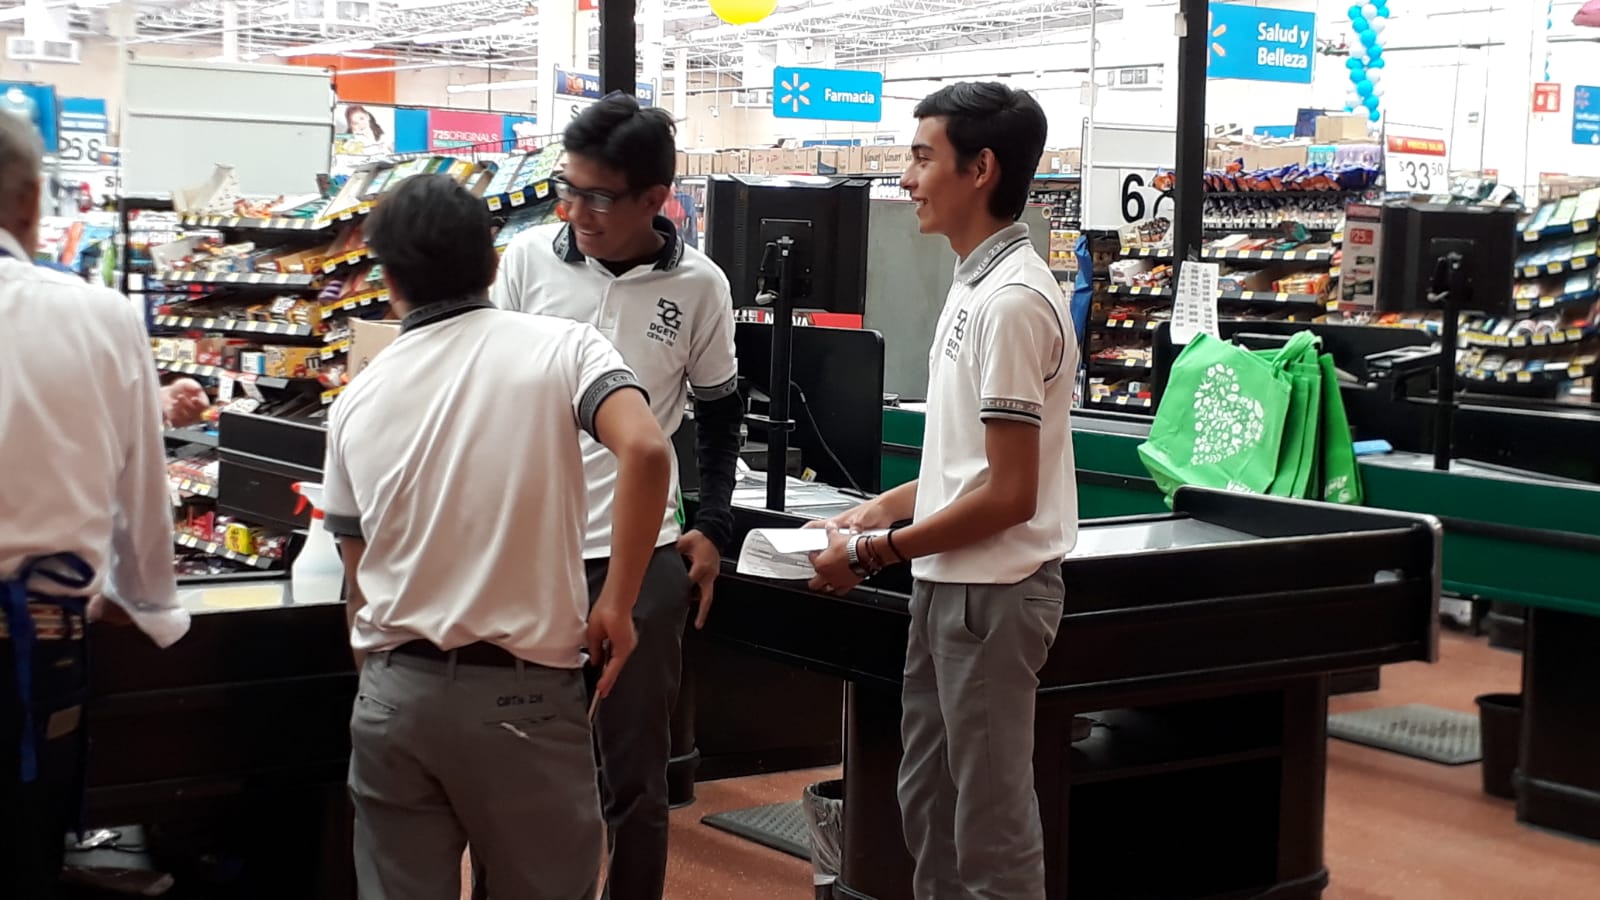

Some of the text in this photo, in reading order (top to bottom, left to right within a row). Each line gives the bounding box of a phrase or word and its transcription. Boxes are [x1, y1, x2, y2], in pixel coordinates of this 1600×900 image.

[1257, 22, 1310, 49] Salud y
[1257, 47, 1308, 68] Belleza
[824, 88, 875, 104] Farmacia
[649, 321, 678, 341] DGETI
